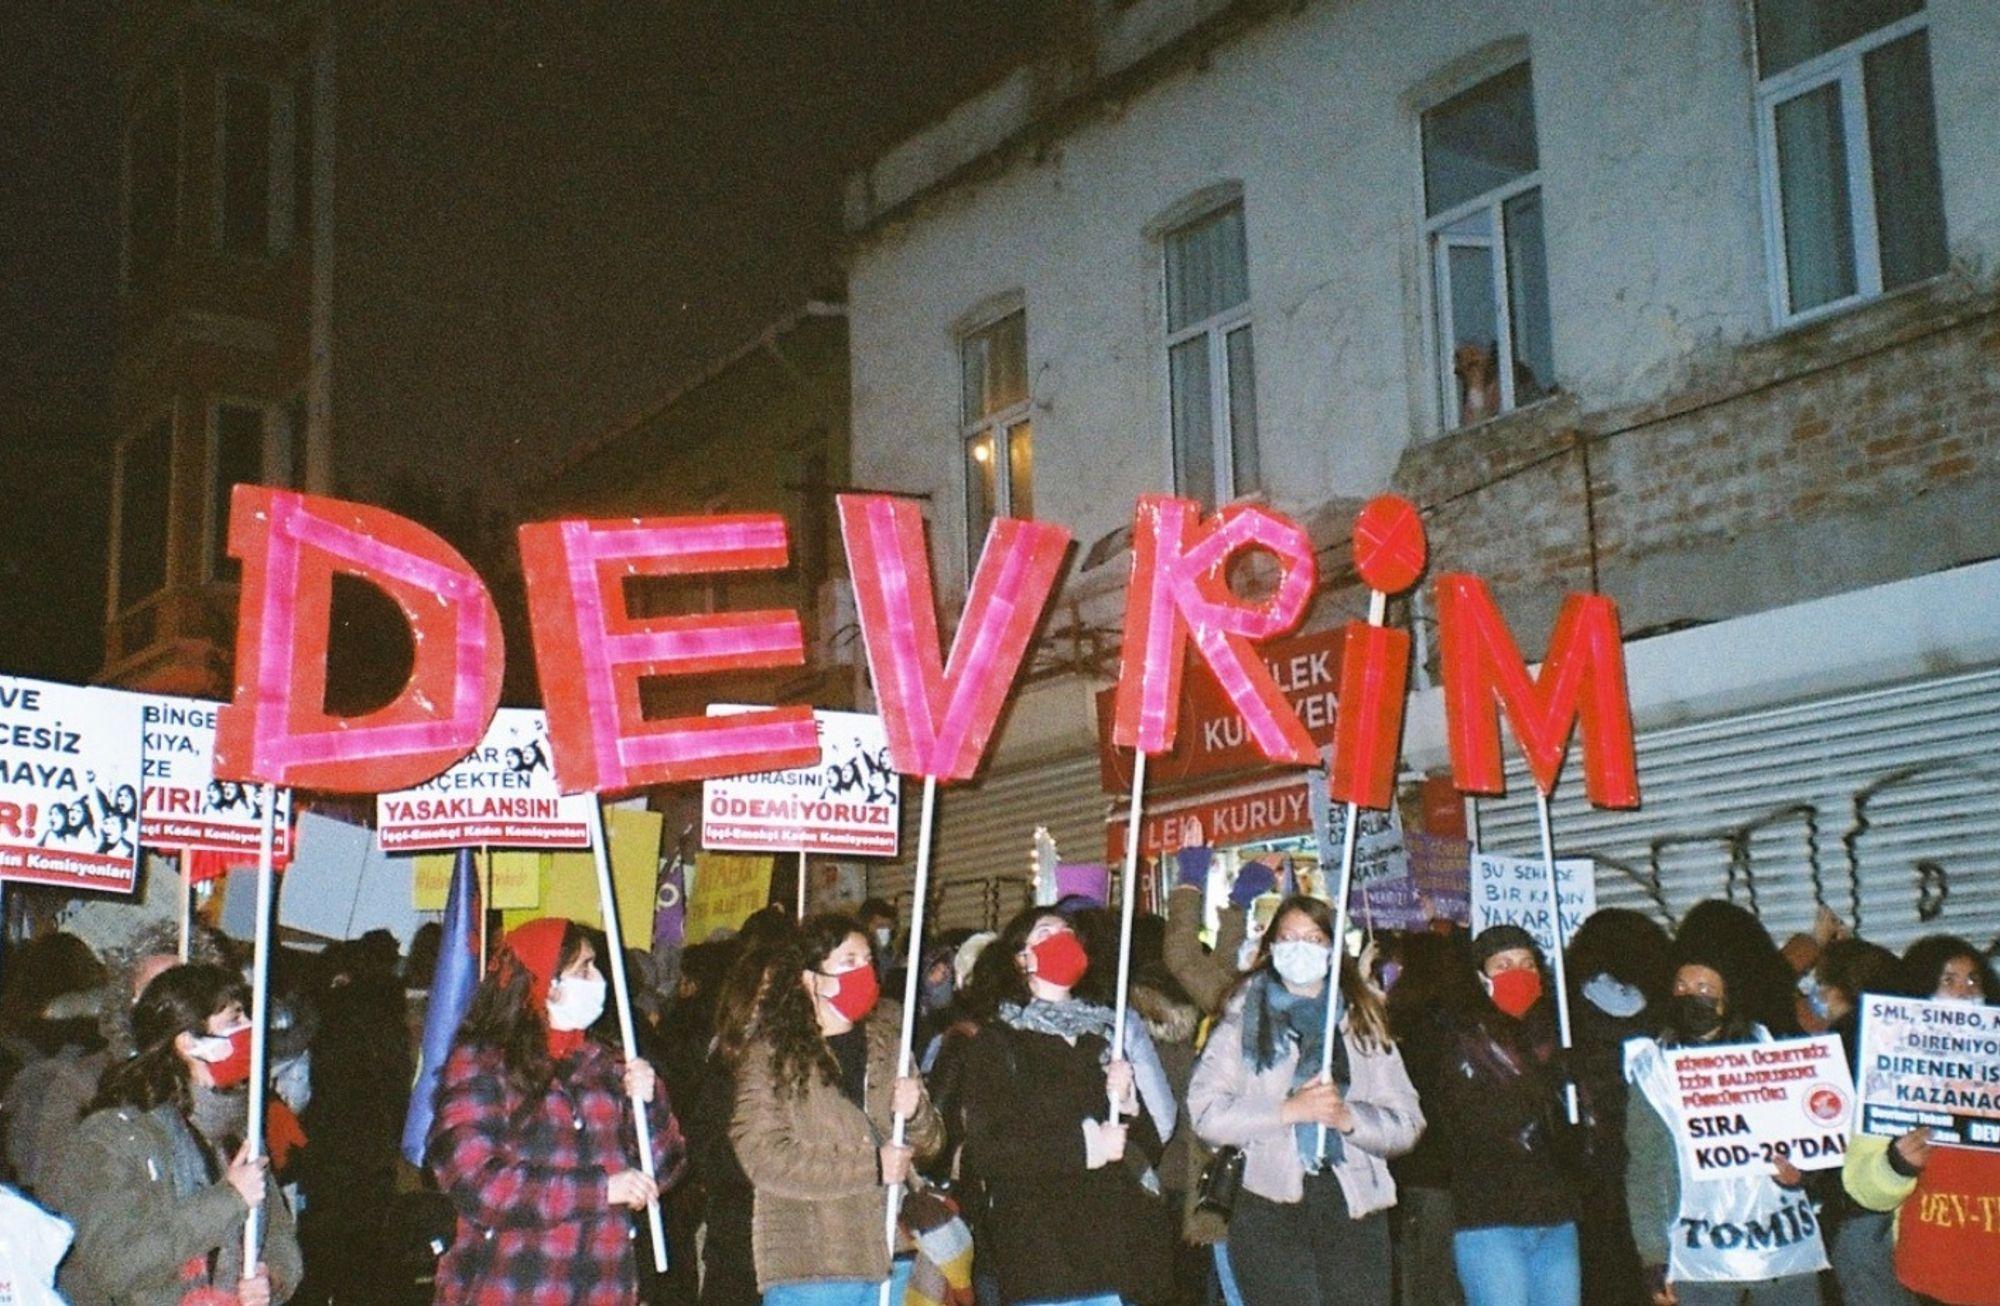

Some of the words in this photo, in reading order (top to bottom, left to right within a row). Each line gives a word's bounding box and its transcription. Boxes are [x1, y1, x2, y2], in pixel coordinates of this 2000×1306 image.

[385, 798, 558, 821] YASAKLANSIN!
[711, 789, 890, 825] ÖDEMİYORUZ!
[1213, 792, 1312, 836] KURUY
[27, 854, 131, 881] Komisyonları
[1688, 1114, 1751, 1139] SIRA
